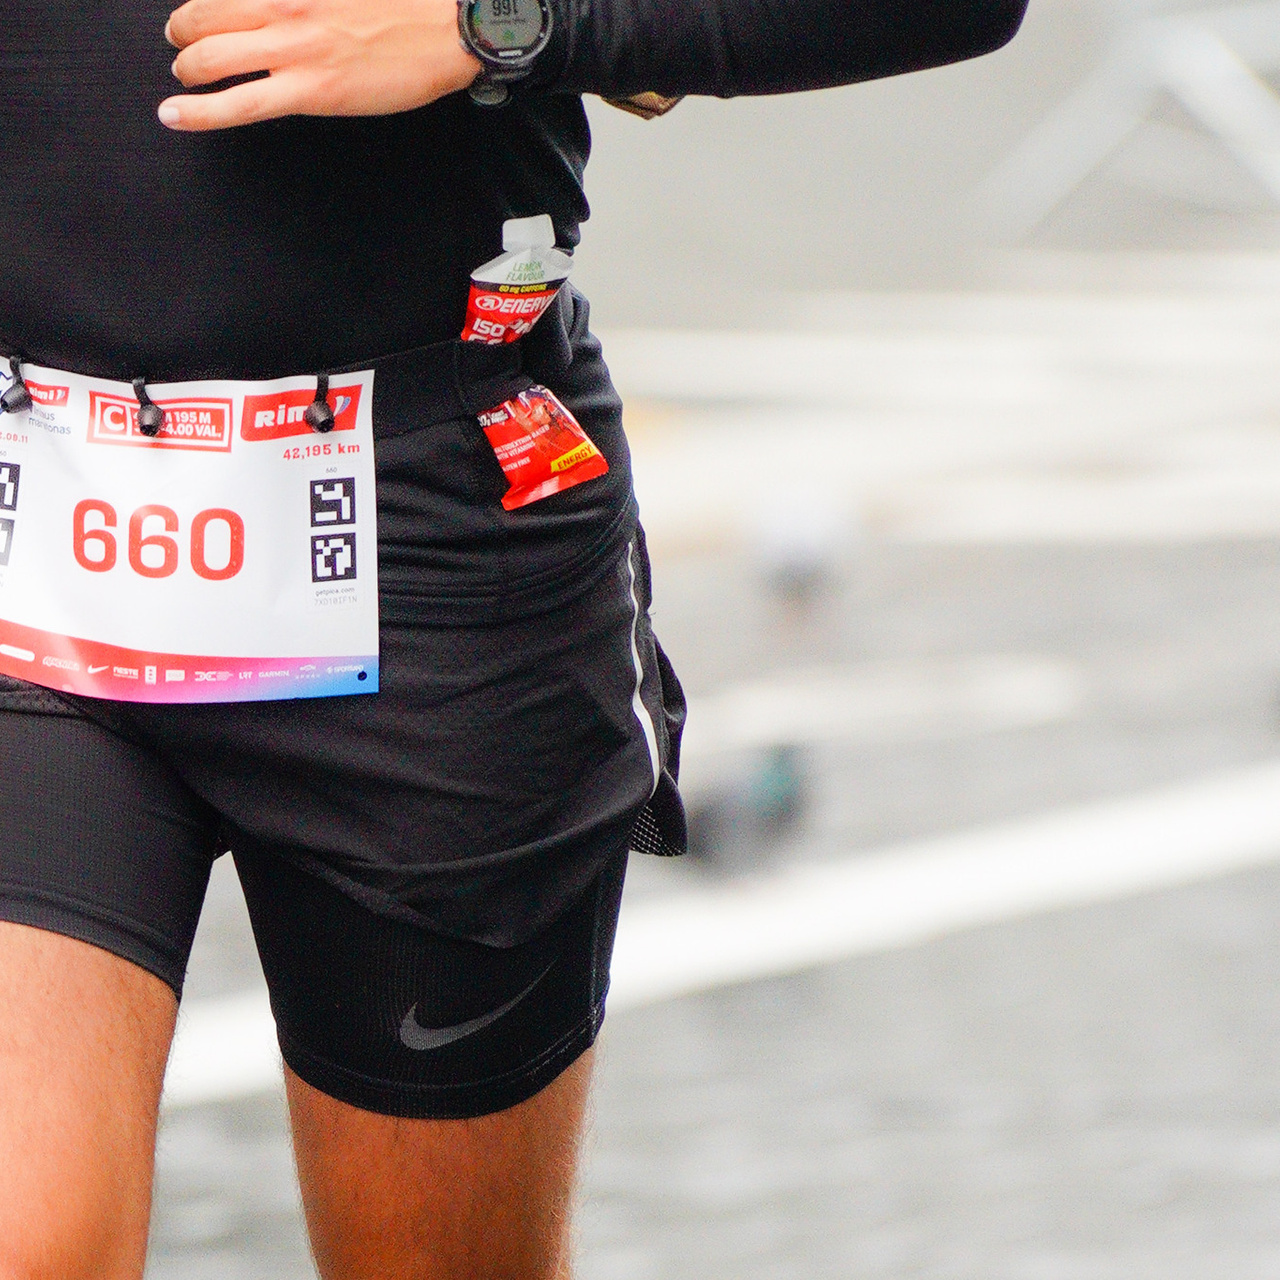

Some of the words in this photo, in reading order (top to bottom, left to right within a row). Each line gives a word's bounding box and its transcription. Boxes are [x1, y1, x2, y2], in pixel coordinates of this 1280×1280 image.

[513, 261, 542, 272] LEMON
[506, 269, 546, 281] FLAVOUR
[103, 405, 125, 431] C
[173, 411, 197, 424] 195
[199, 412, 211, 424] M
[195, 425, 222, 437] VAL.
[283, 444, 332, 460] 42,195
[338, 443, 360, 454] km
[557, 445, 593, 470] ENERGY
[72, 498, 245, 581] 660
[258, 670, 290, 678] GARMIN
